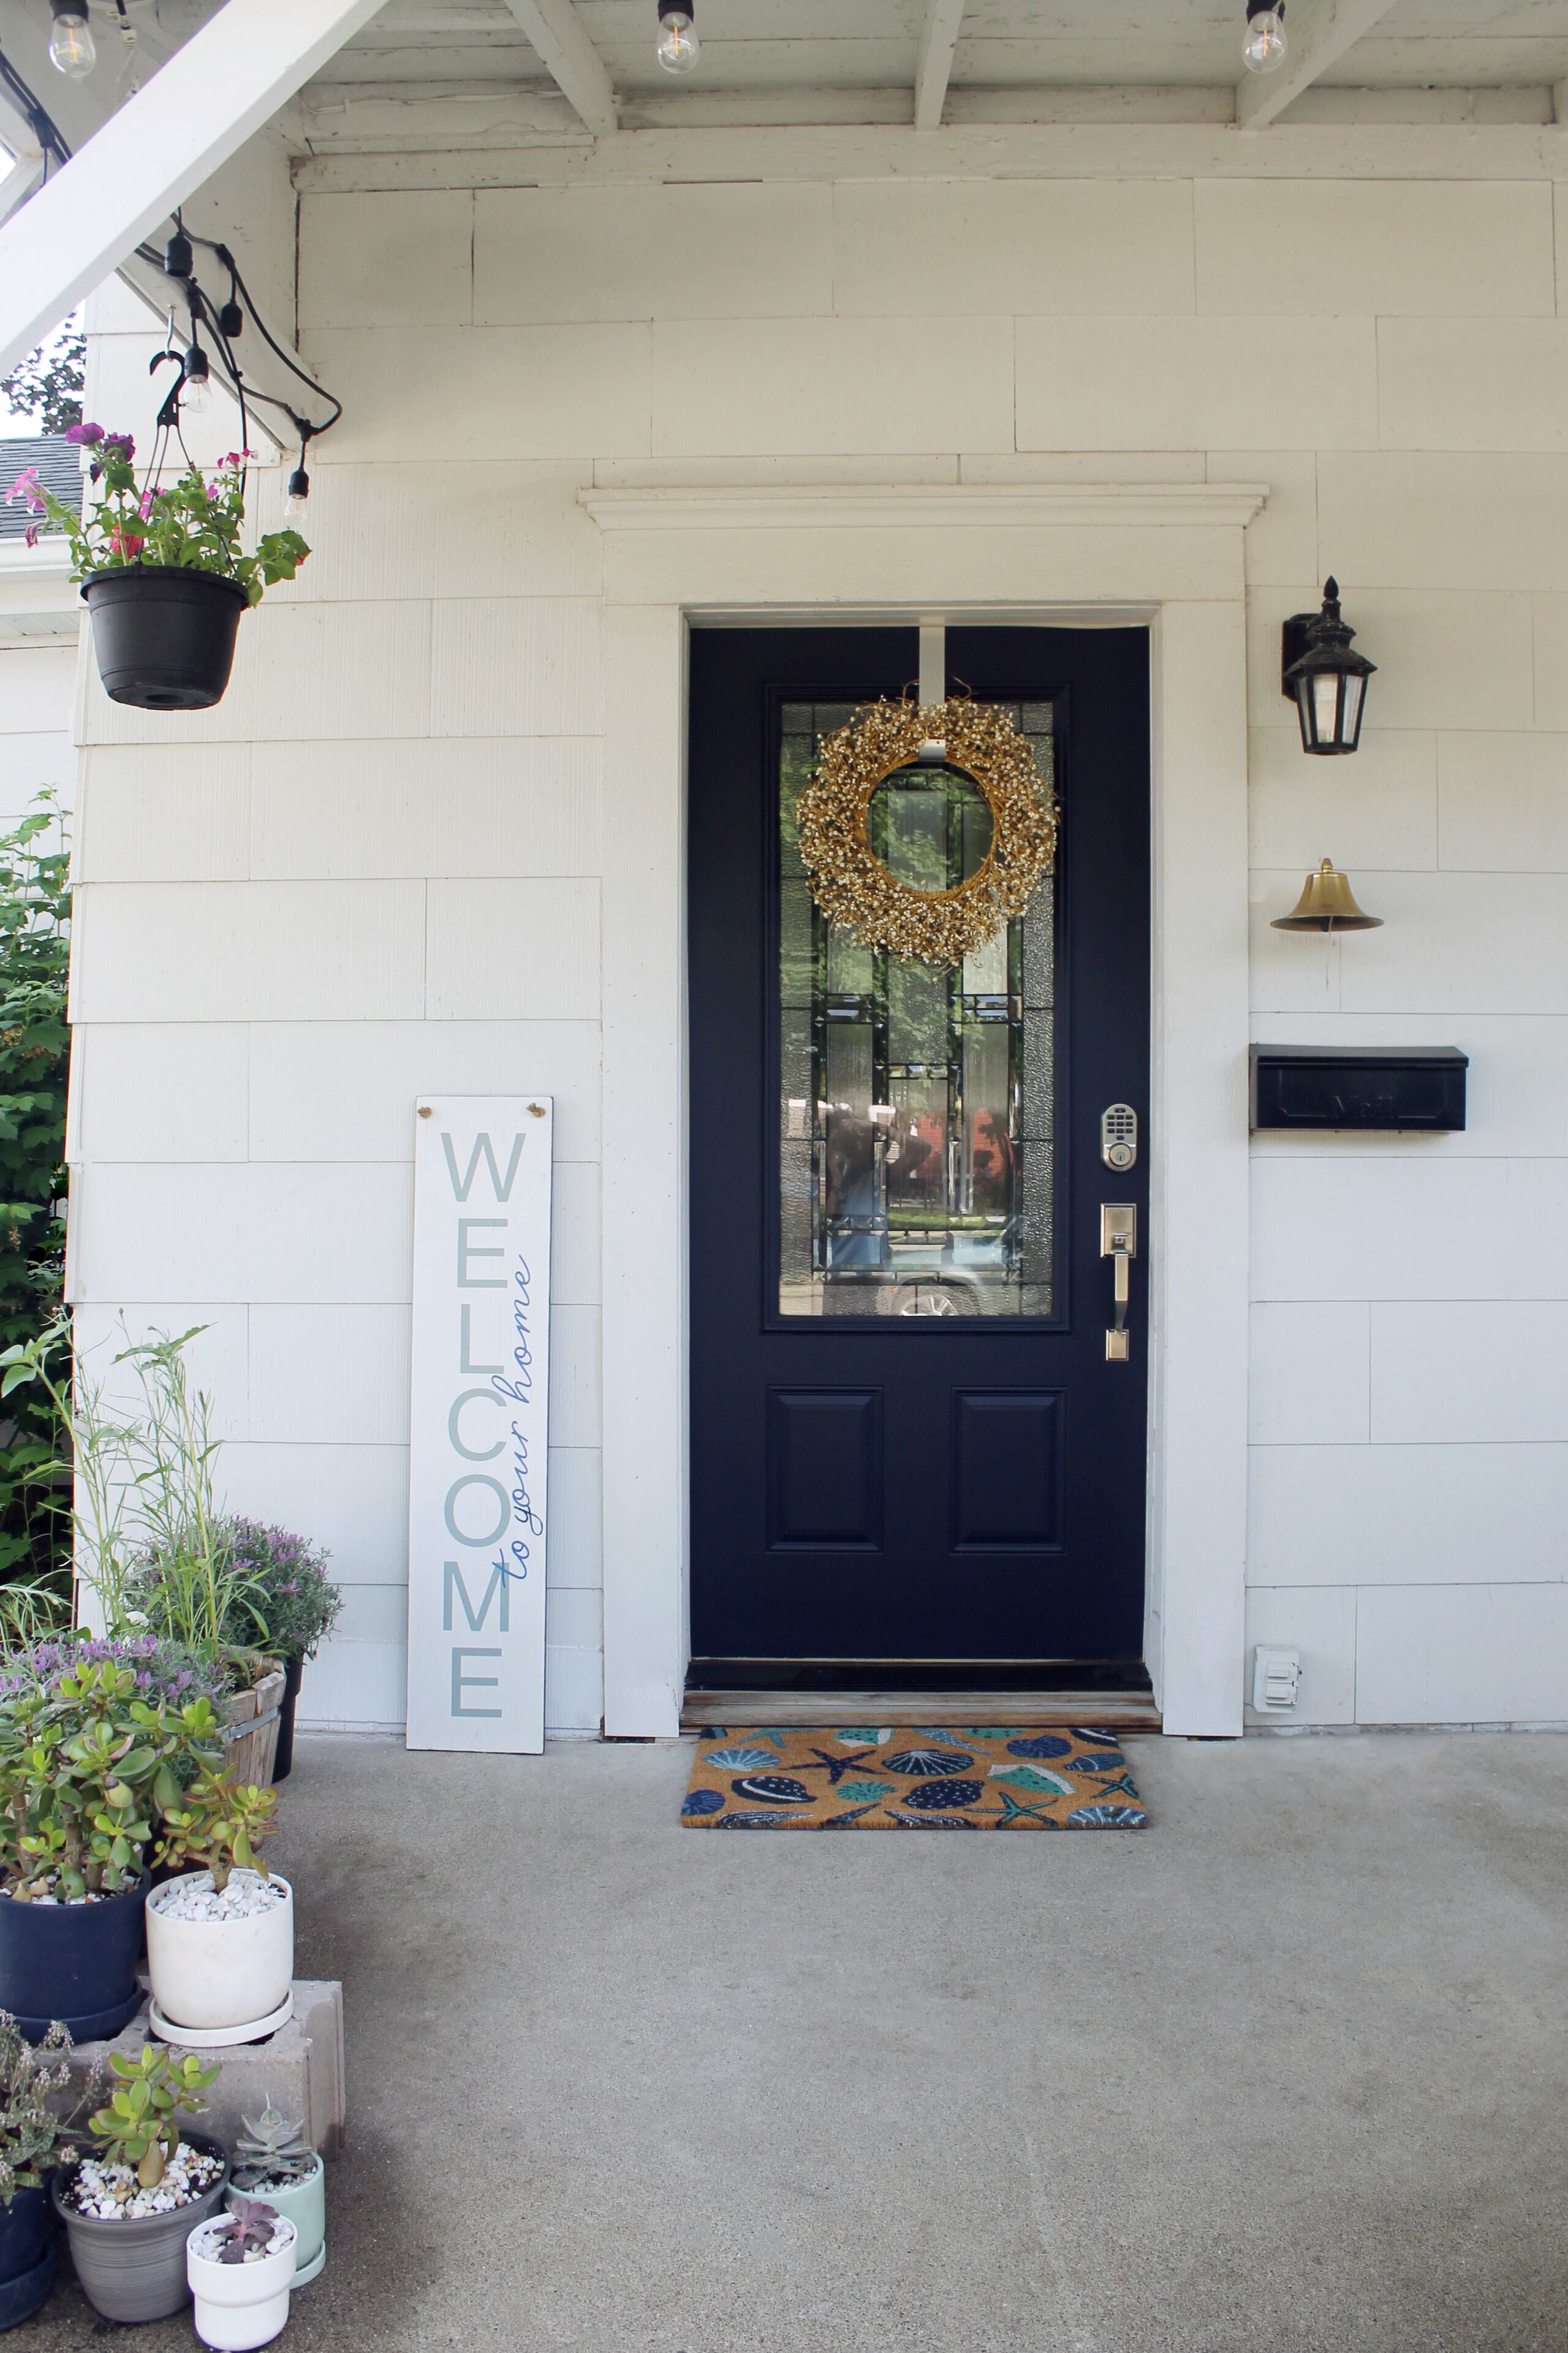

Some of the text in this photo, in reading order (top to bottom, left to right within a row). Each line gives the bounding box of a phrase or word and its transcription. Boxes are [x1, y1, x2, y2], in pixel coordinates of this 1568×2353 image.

[439, 1132, 526, 1718] WELCOME
[491, 1254, 543, 1589] to your home
